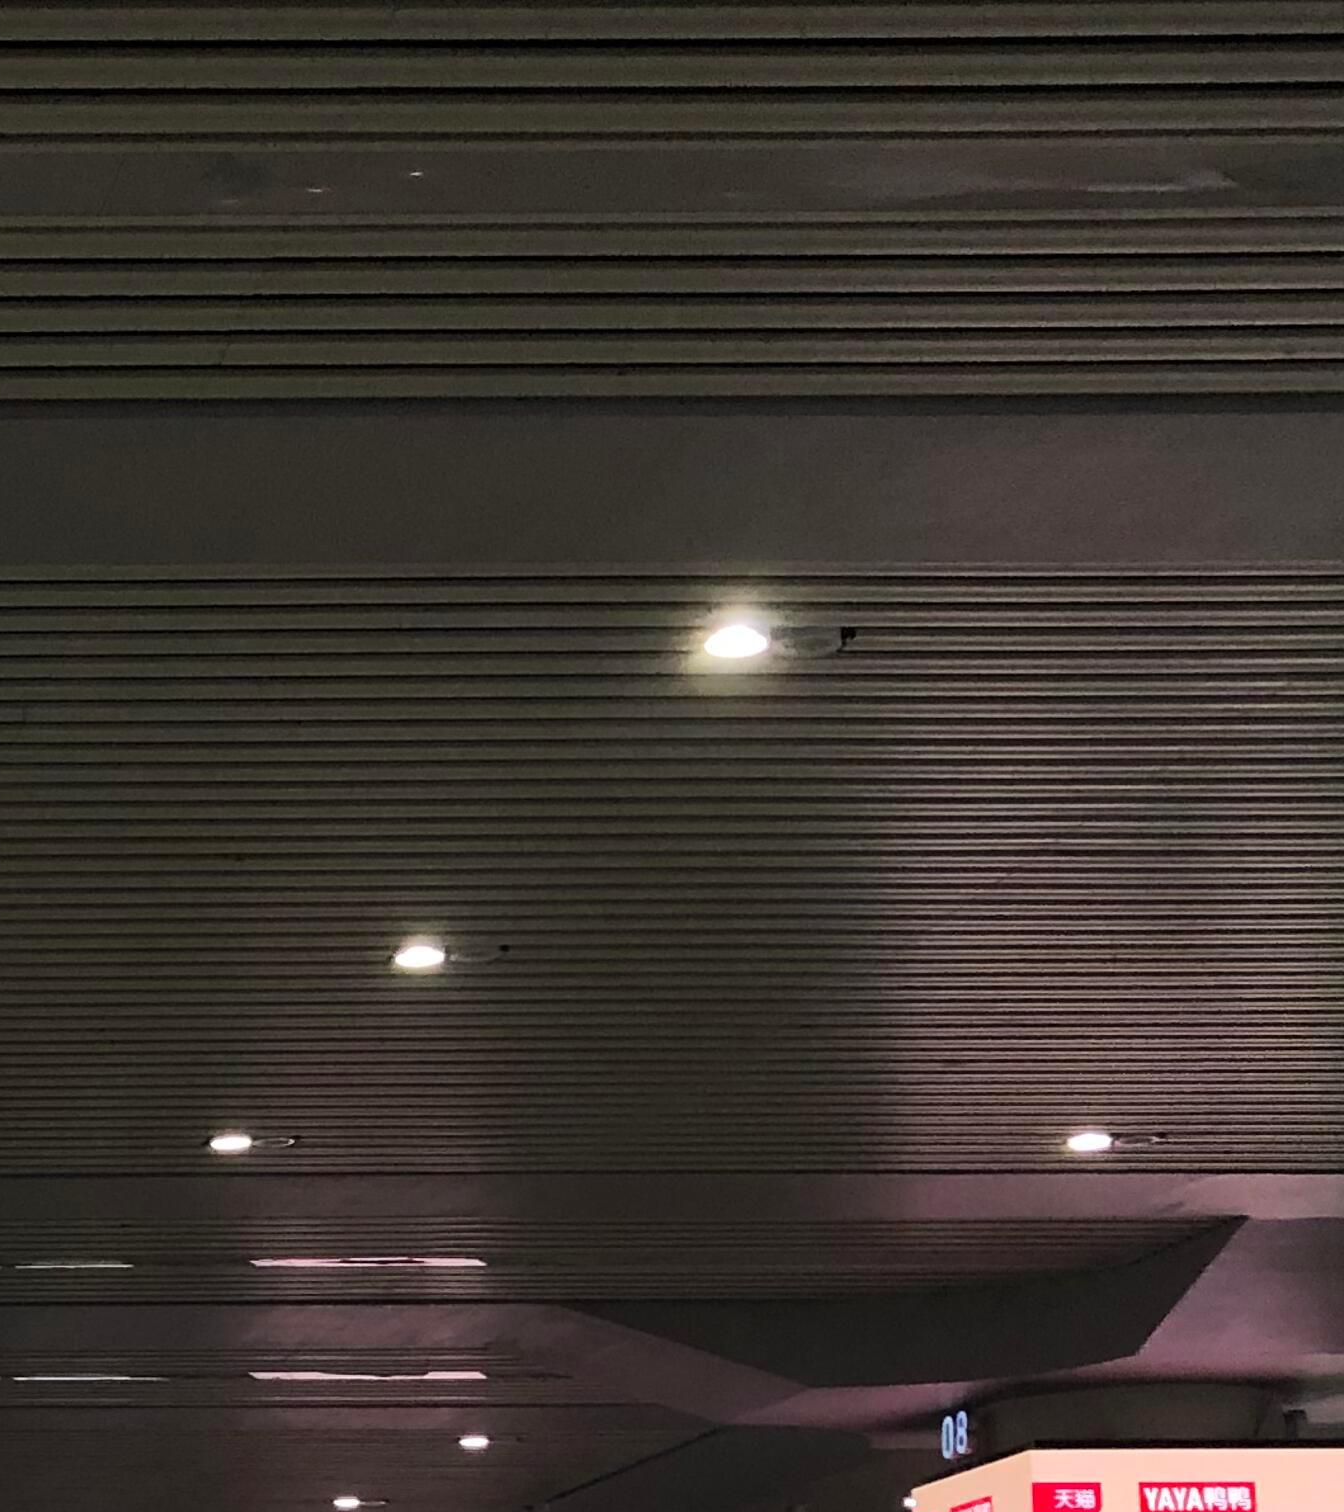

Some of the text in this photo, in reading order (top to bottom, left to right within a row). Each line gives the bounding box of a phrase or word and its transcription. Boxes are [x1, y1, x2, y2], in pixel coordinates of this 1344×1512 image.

[941, 1410, 968, 1460] 08
[1054, 1488, 1096, 1509] 天猫
[1143, 1486, 1252, 1511] YAYA鸭鸭
